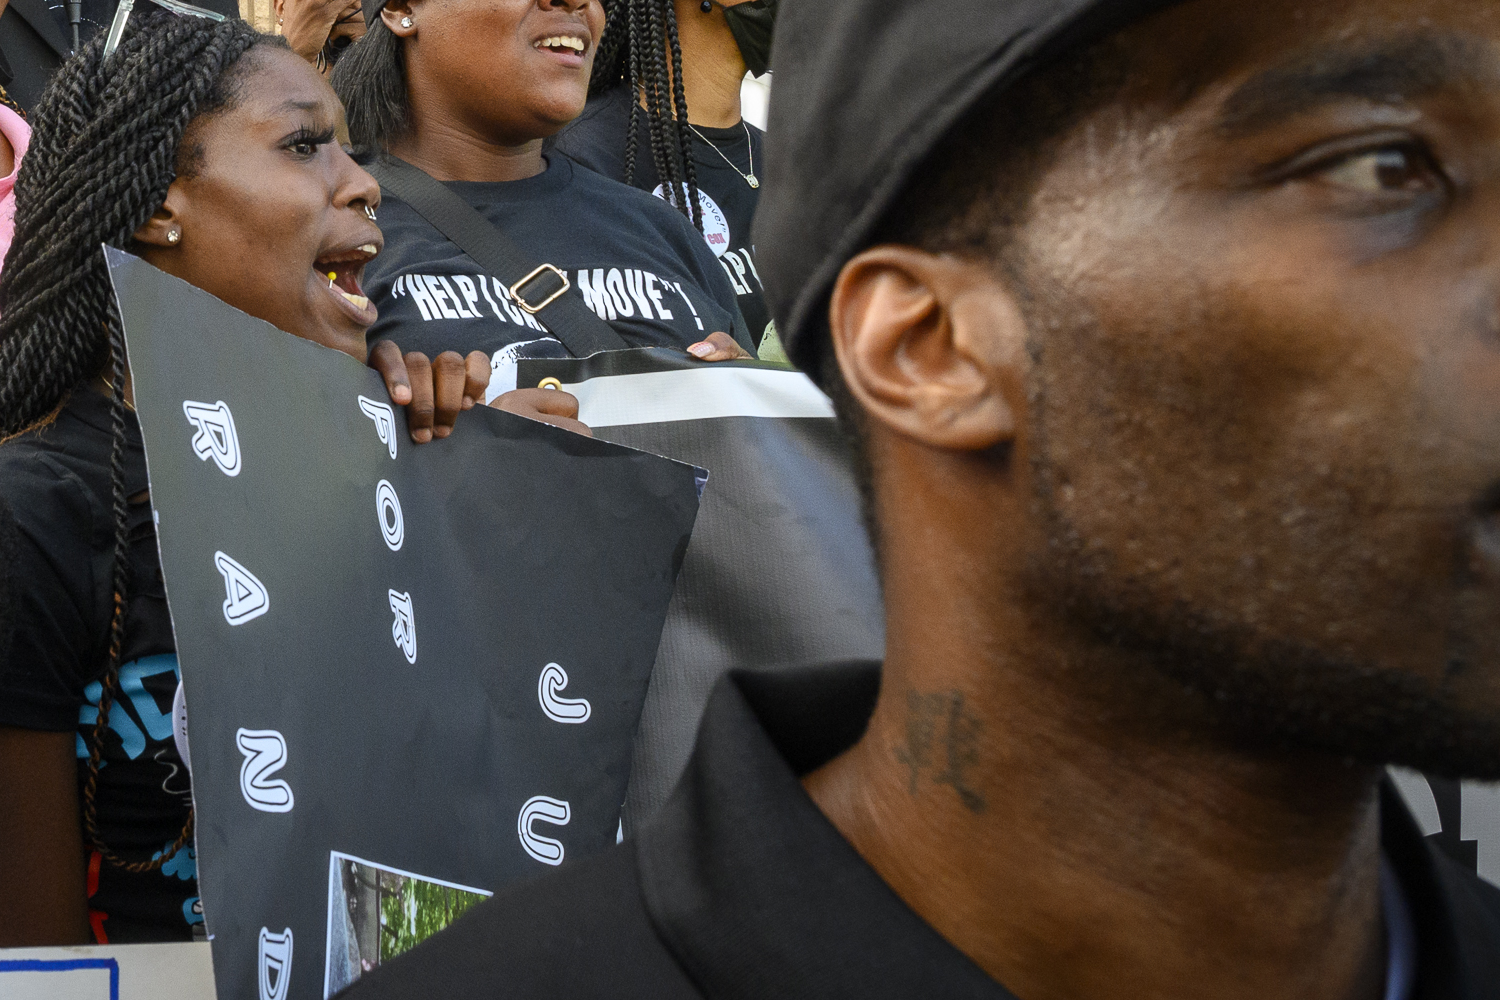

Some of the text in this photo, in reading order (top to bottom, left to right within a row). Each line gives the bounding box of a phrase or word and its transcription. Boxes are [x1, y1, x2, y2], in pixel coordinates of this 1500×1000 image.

[391, 273, 484, 322] "HELP
[477, 274, 508, 323] I
[707, 233, 726, 244] COX
[358, 394, 418, 665] FOR
[182, 399, 294, 1000] RAND
